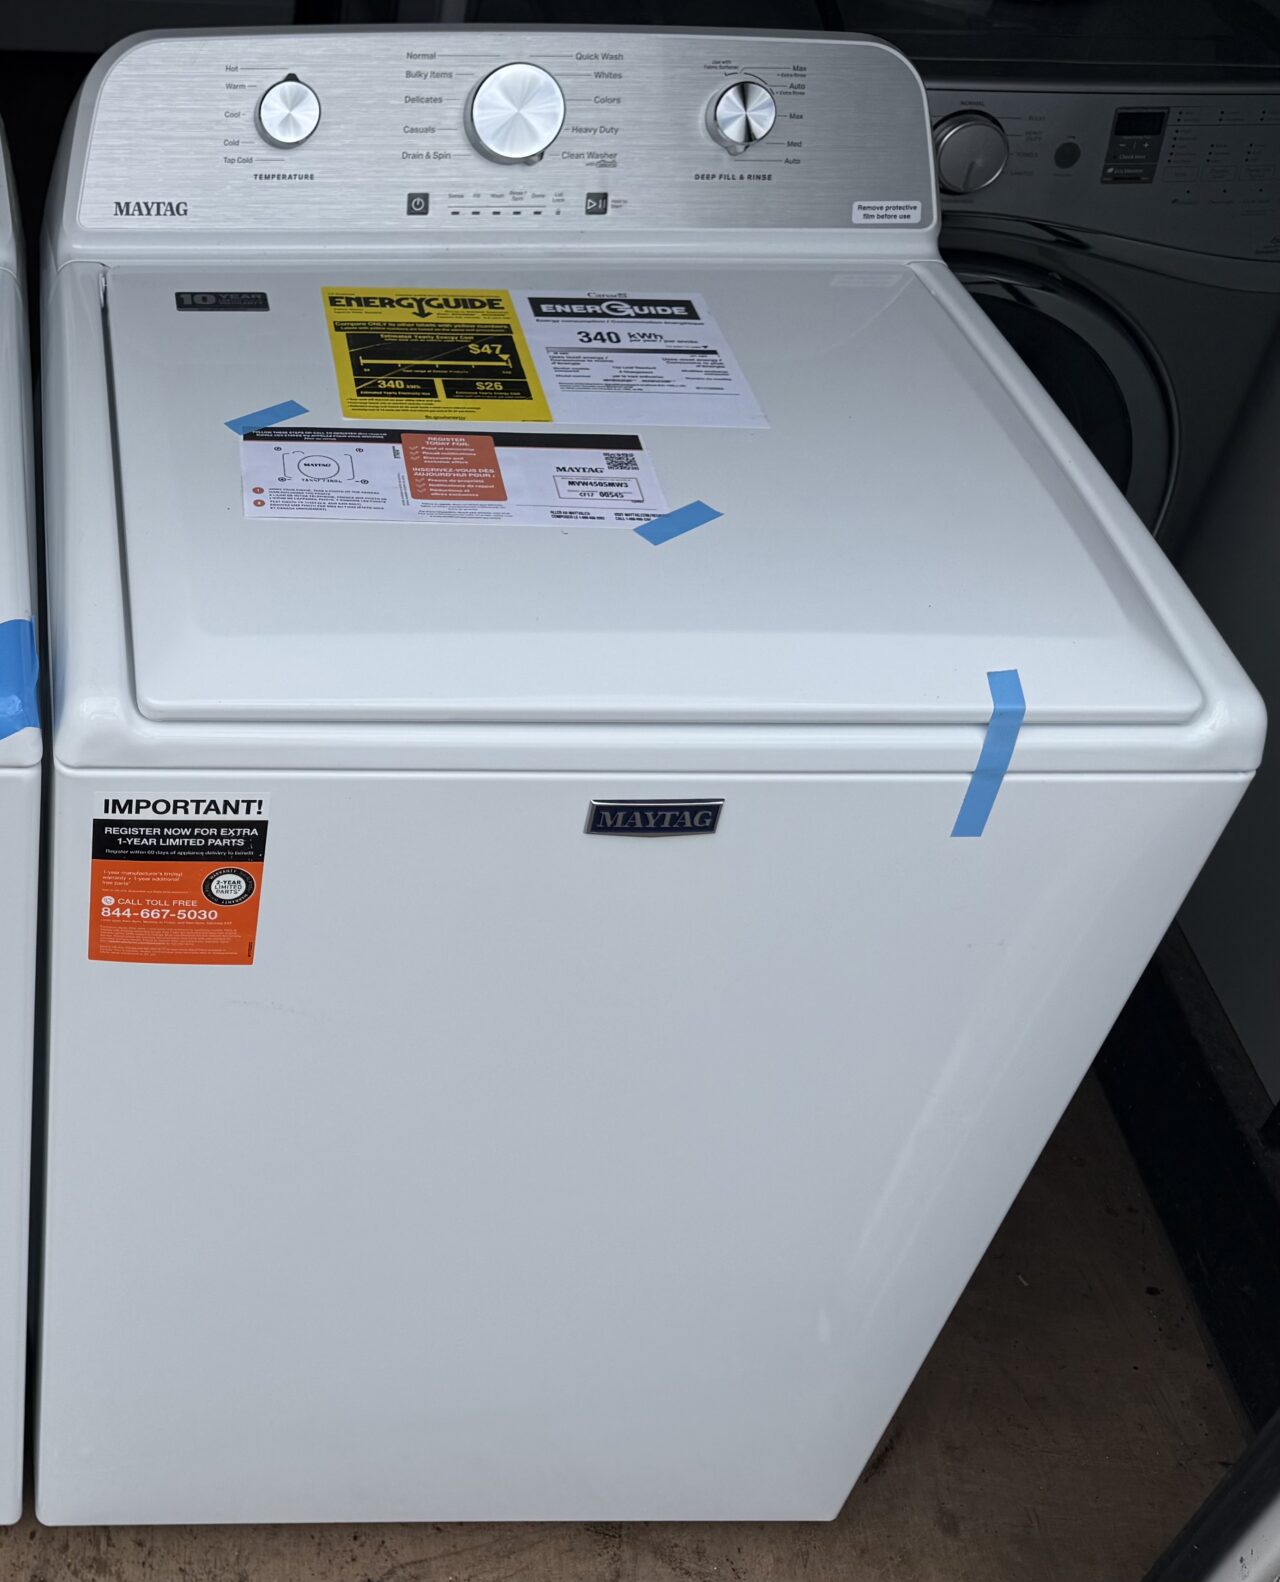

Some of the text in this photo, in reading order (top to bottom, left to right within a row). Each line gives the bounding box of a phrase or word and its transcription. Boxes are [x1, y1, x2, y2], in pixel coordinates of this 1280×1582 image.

[575, 53, 599, 61] Quick
[406, 71, 427, 79] Bulky
[594, 96, 621, 104] Colors
[572, 126, 619, 134] Heavy Duty
[433, 152, 451, 161] Spin
[114, 201, 188, 216] MAYTAG
[179, 293, 216, 305] 10
[329, 296, 505, 312] ENERGYGUIDE
[577, 331, 663, 343] 340 kWh
[468, 344, 502, 355] $47
[377, 380, 404, 388] 340
[476, 382, 503, 390] $26
[103, 799, 263, 815] IMPORTANT!
[597, 811, 712, 827] MAYTAG
[105, 827, 160, 835] REGISTER
[160, 838, 205, 846] LIMITED
[208, 838, 244, 846] PARTS
[101, 908, 218, 920] 844-667-5030
